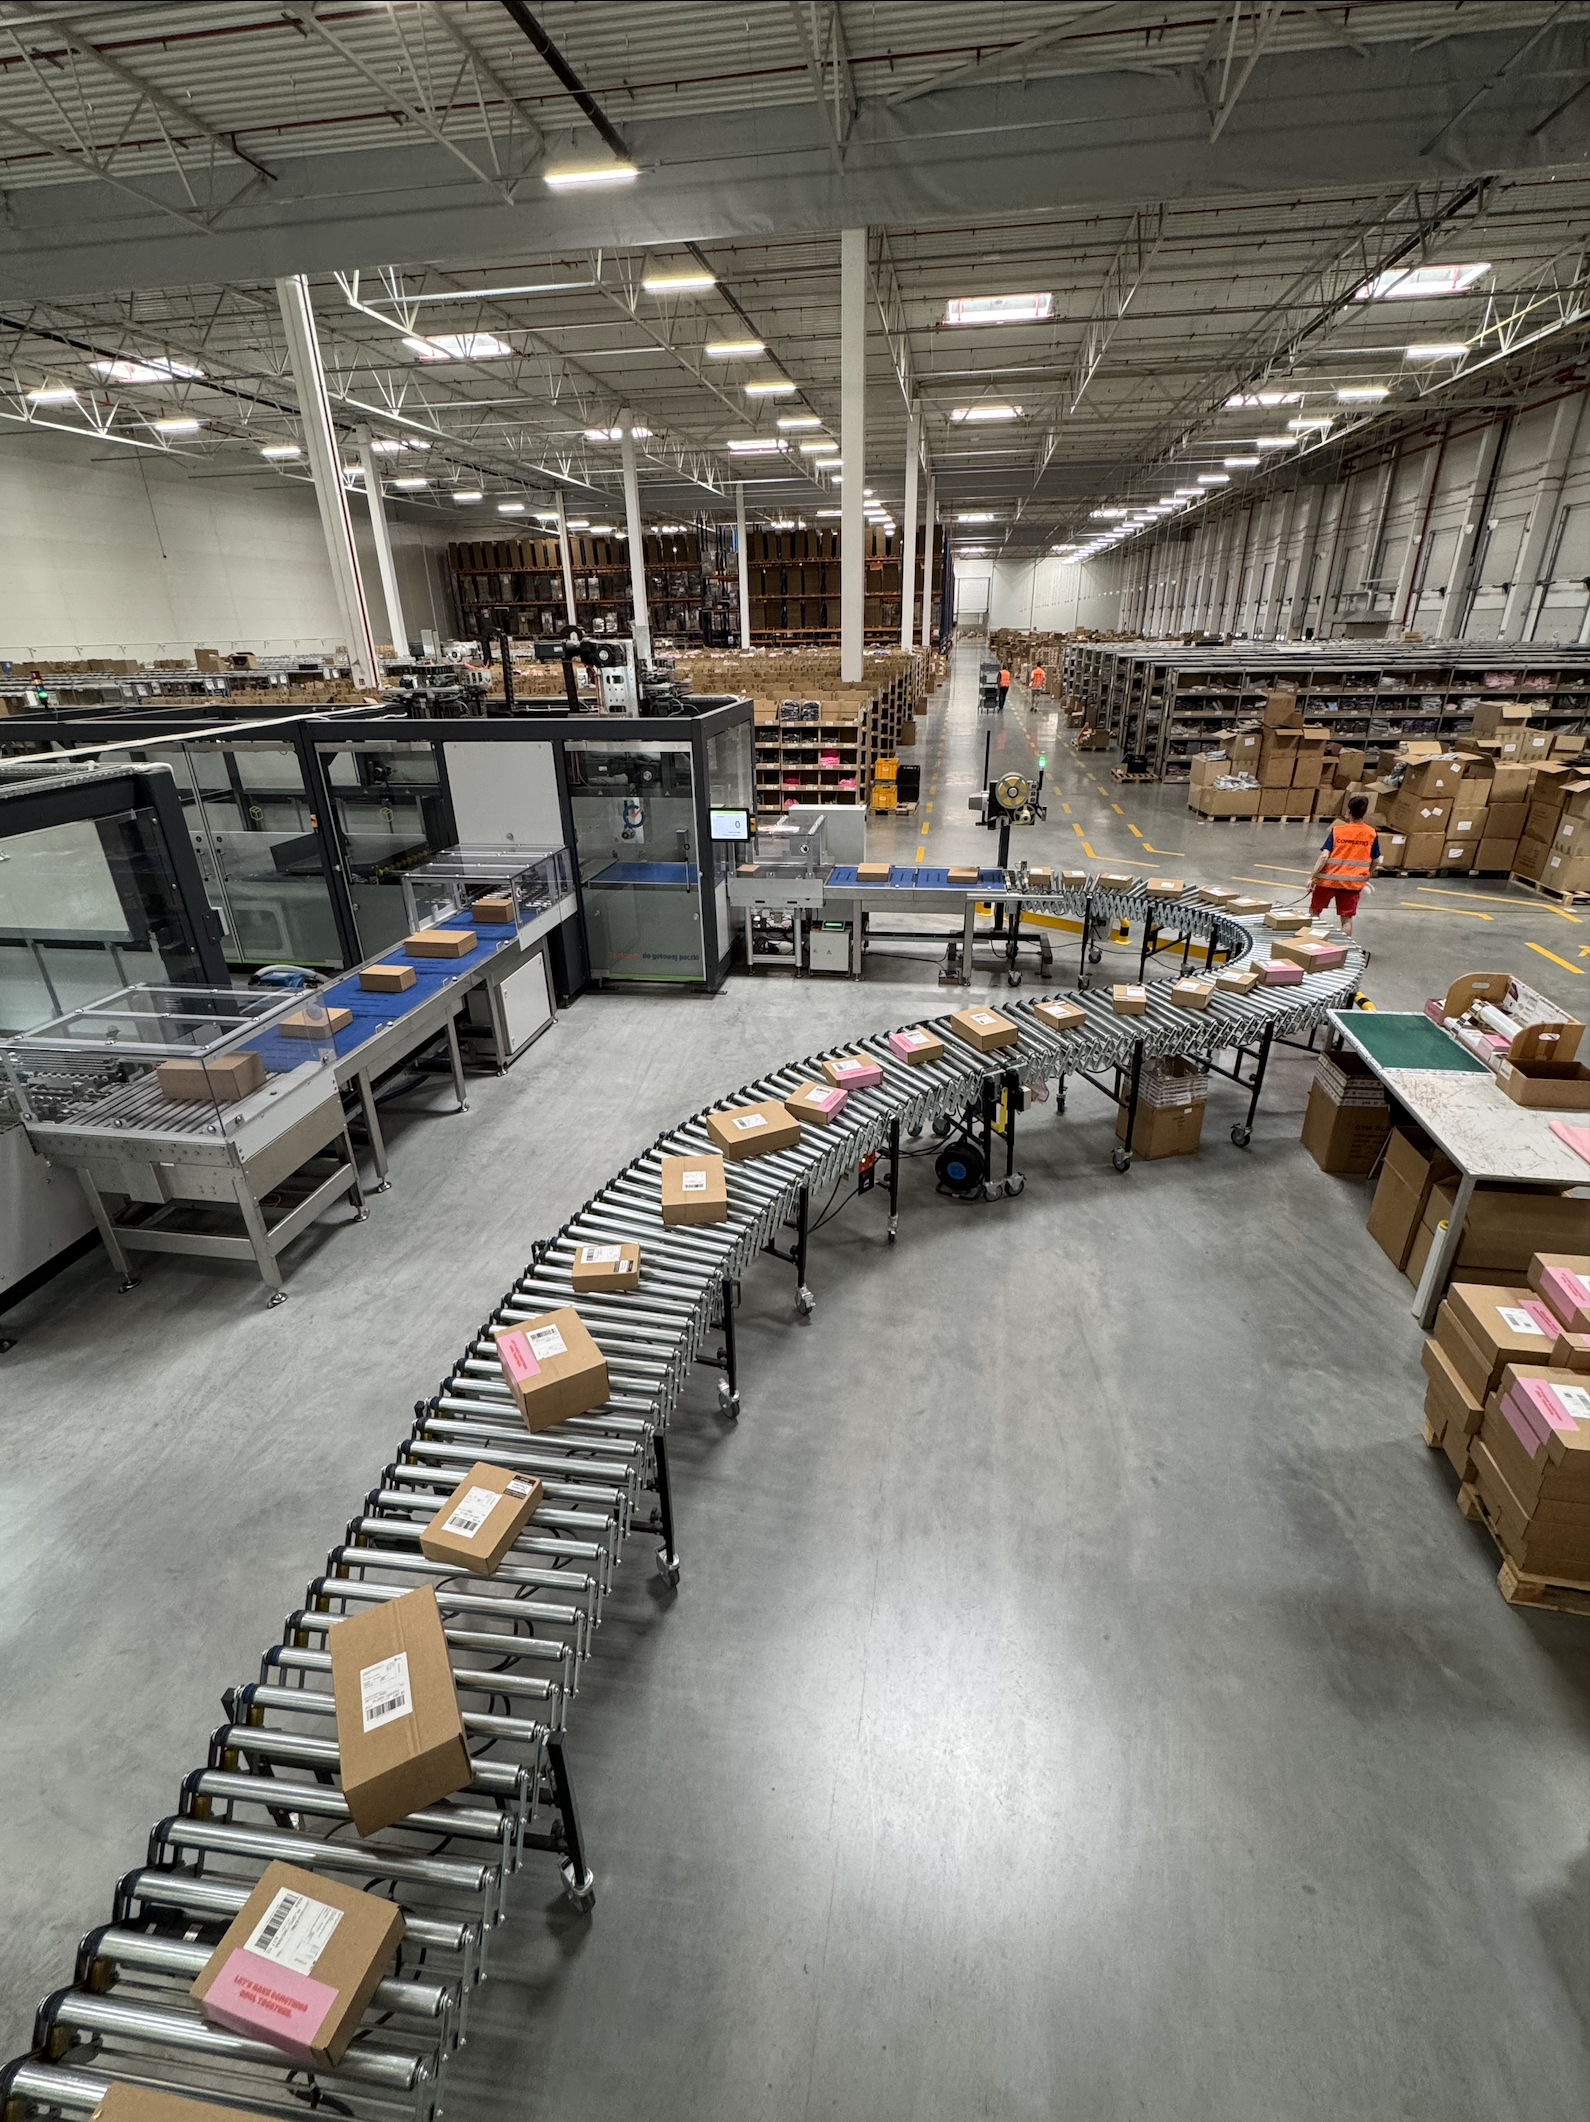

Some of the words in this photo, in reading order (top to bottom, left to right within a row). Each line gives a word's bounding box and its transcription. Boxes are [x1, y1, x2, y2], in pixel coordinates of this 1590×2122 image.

[734, 820, 741, 829] 0
[652, 953, 678, 961] gotowej
[679, 953, 700, 961] paczki
[233, 1974, 252, 1989] LET'S
[252, 1982, 272, 1997] MAKE
[270, 1990, 309, 2013] SOMETHING
